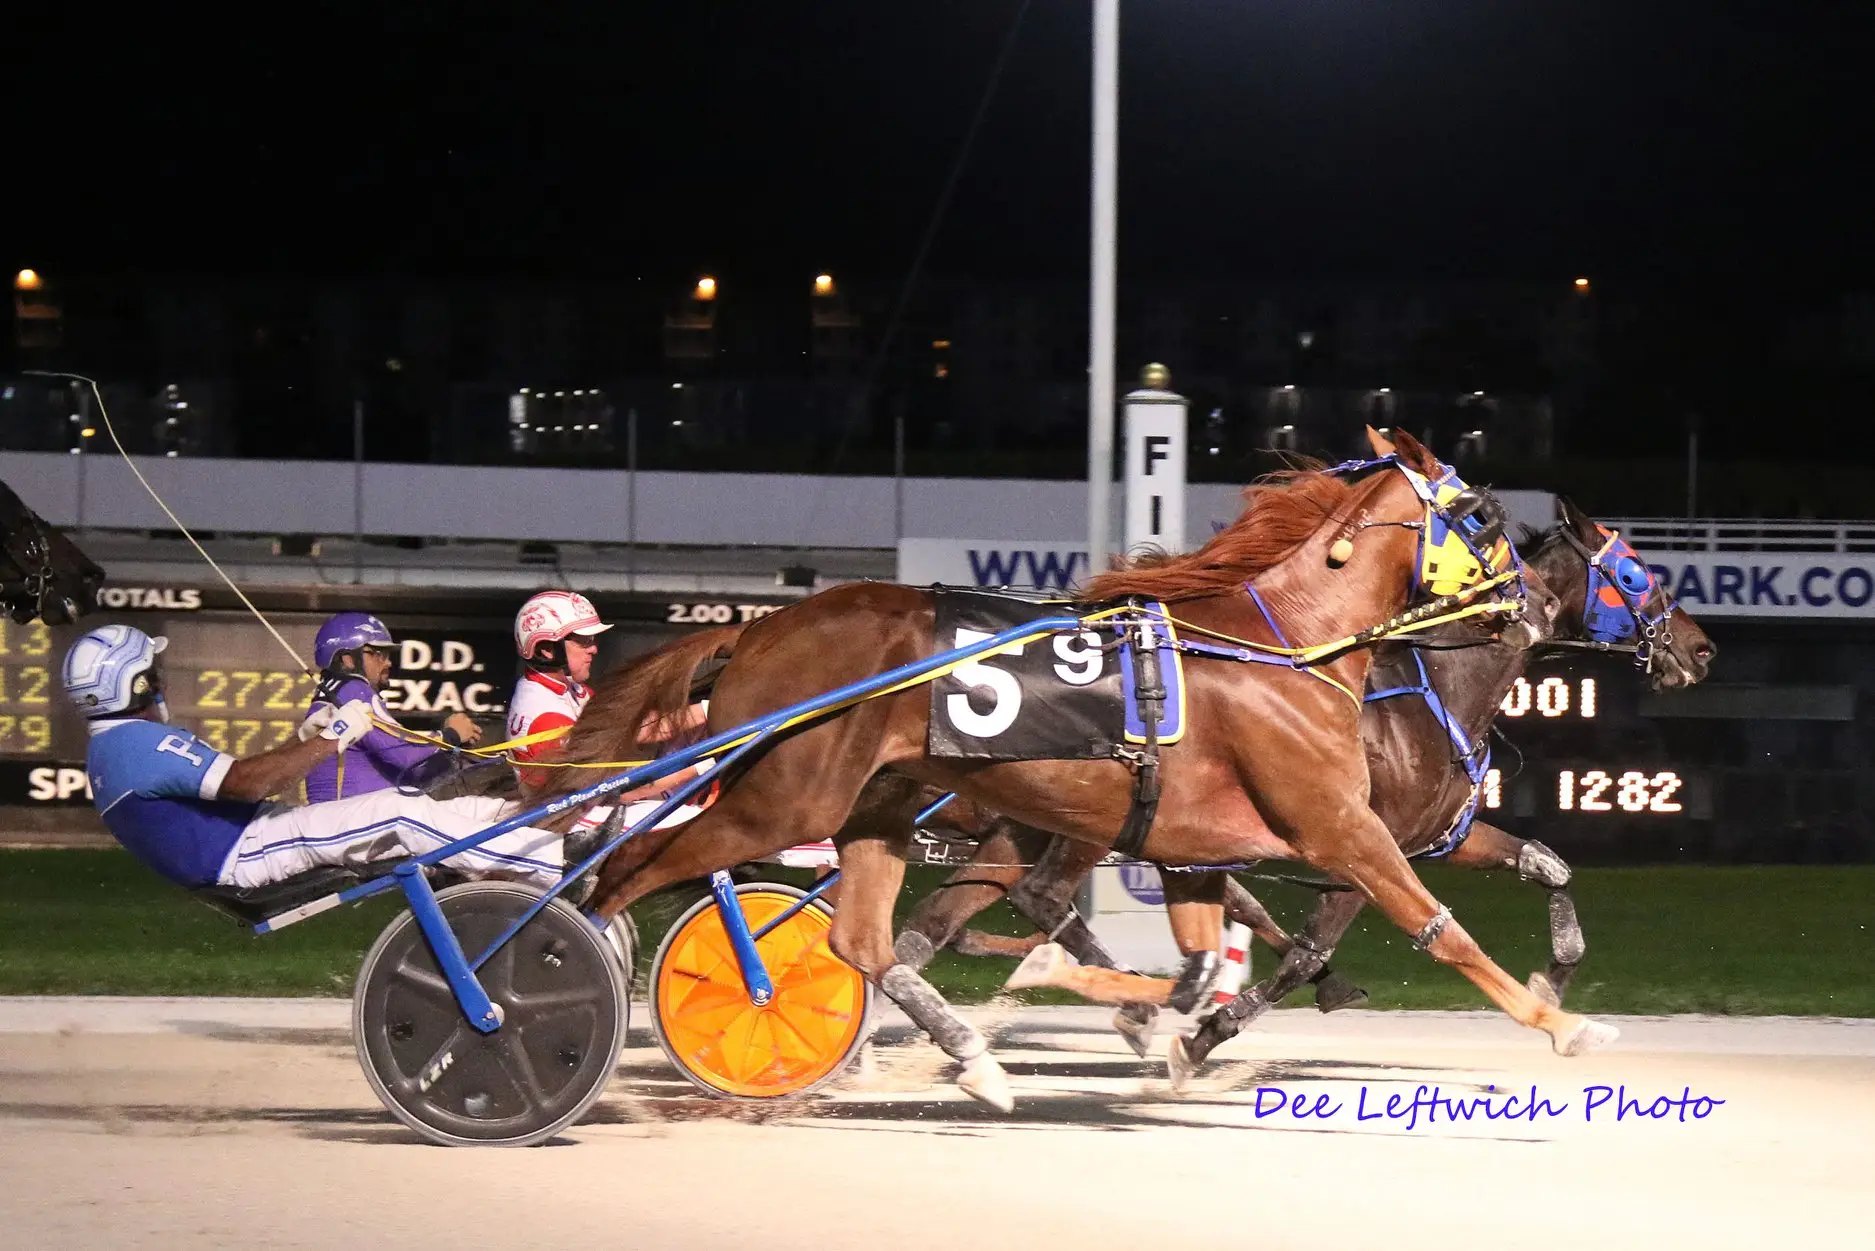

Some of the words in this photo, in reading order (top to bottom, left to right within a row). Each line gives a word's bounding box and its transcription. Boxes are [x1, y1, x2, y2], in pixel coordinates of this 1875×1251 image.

[667, 603, 733, 624] 2.00
[399, 639, 485, 672] D.D.
[1052, 627, 1104, 686] 9
[379, 678, 505, 713] EXAC.
[947, 627, 1025, 738] 5
[1559, 770, 1683, 812] 1282
